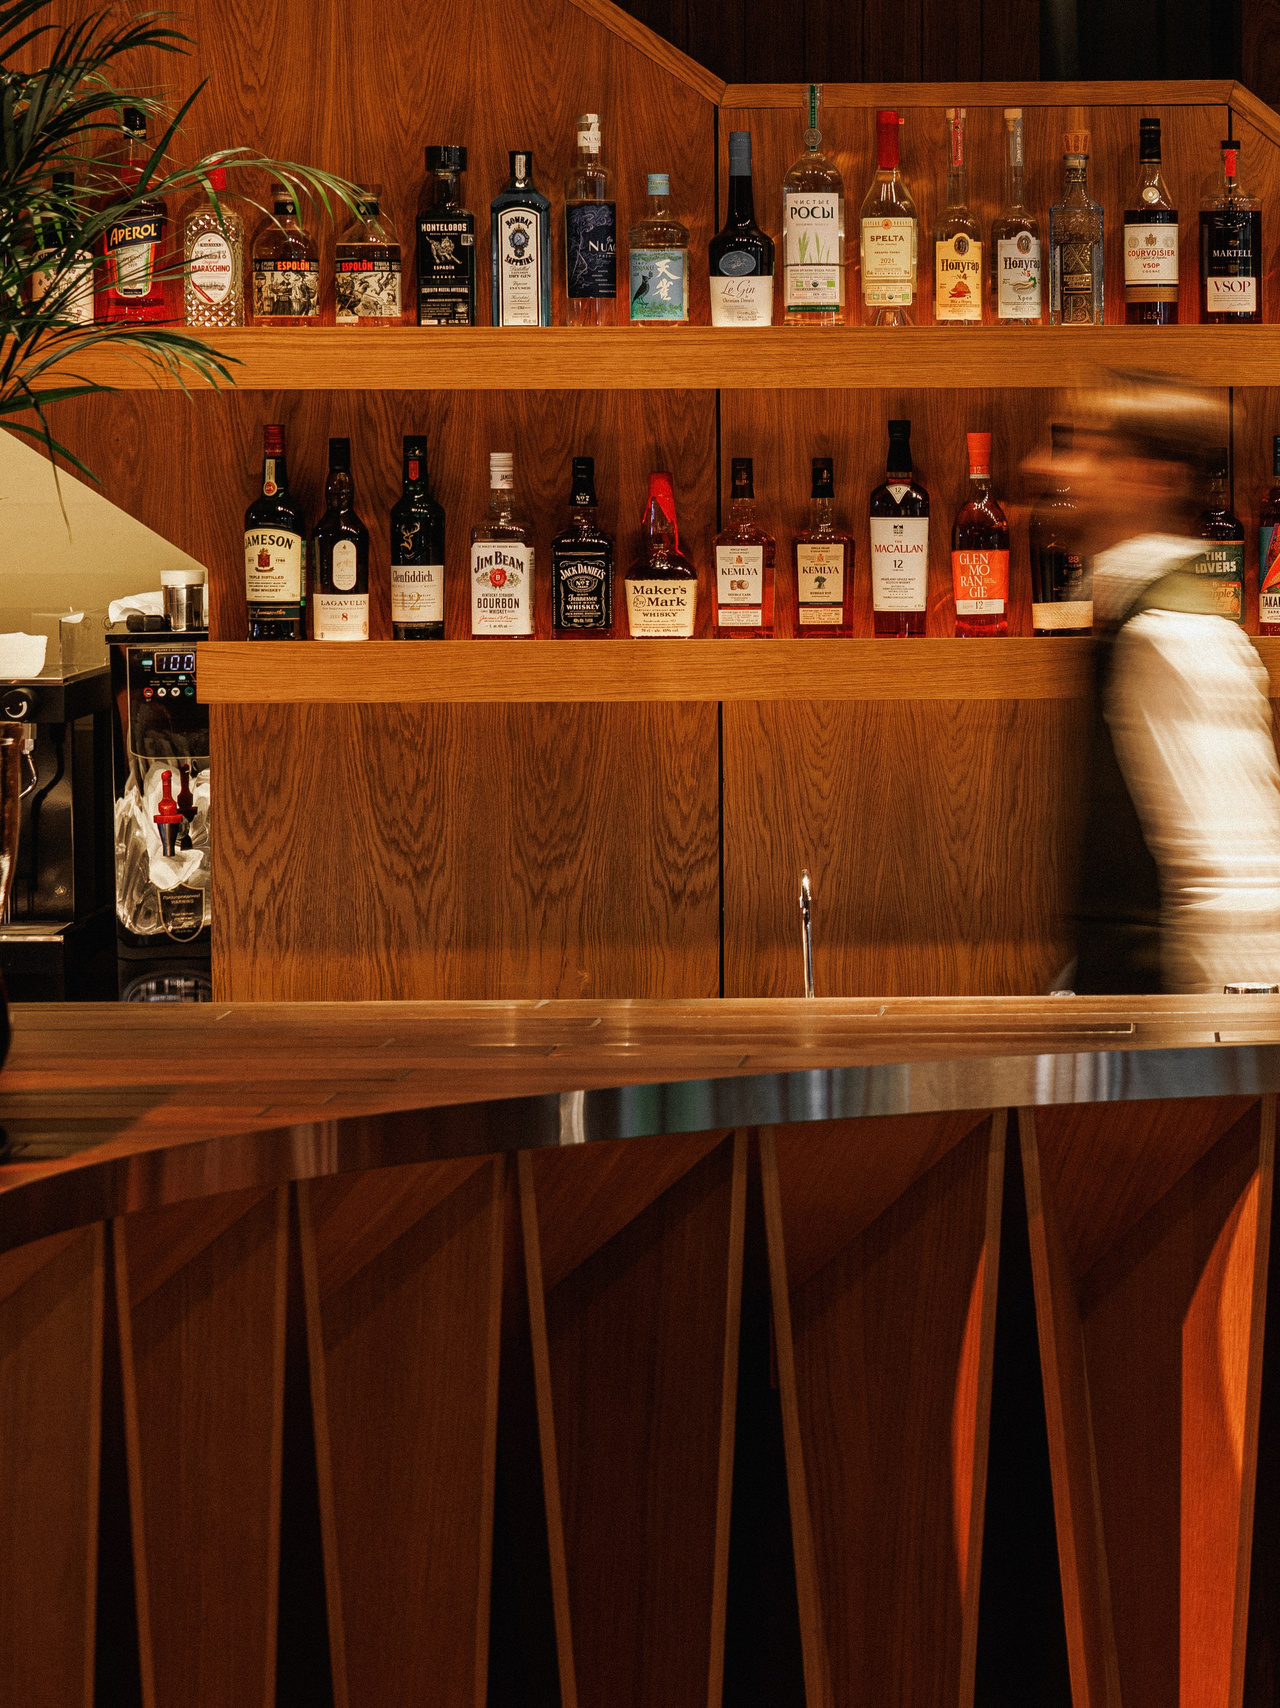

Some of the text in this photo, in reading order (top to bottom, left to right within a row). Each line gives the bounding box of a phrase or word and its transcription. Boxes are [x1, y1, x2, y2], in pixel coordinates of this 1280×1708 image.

[790, 206, 834, 220] РОСЫ
[421, 223, 467, 232] MONTELOBOS
[505, 216, 533, 229] BOMBAY
[110, 223, 157, 246] APEROL
[1127, 249, 1175, 257] COURVOISIER
[1212, 249, 1252, 258] MARTELL
[504, 254, 536, 266] SAPPHIRE
[940, 258, 980, 274] Полугар
[192, 265, 231, 273] MARASCHINO
[721, 279, 756, 298] Le Gin
[1213, 280, 1251, 293] VSOP
[974, 466, 981, 474] 12
[244, 534, 294, 550] JAMESON
[874, 544, 924, 553] MACALLAN
[959, 553, 989, 565] GLEN
[1205, 551, 1227, 561] TIKI
[474, 551, 524, 574] JIM BEAM
[893, 560, 903, 569] 12
[1195, 561, 1237, 574] LOVERS
[560, 563, 606, 580] JACK DANIEL'S
[721, 568, 758, 576] KEMLYA
[802, 566, 840, 574] KEMLYA
[969, 564, 990, 576] MO
[960, 575, 983, 587] RAN
[632, 585, 687, 595] Maker's
[969, 586, 988, 598] GIE
[400, 591, 421, 611] 12
[477, 597, 520, 609] BOURBON
[568, 593, 598, 602] Tennessee
[647, 597, 687, 607] Mark
[975, 601, 984, 610] 12
[341, 612, 349, 622] 8
[162, 654, 194, 671] 100
